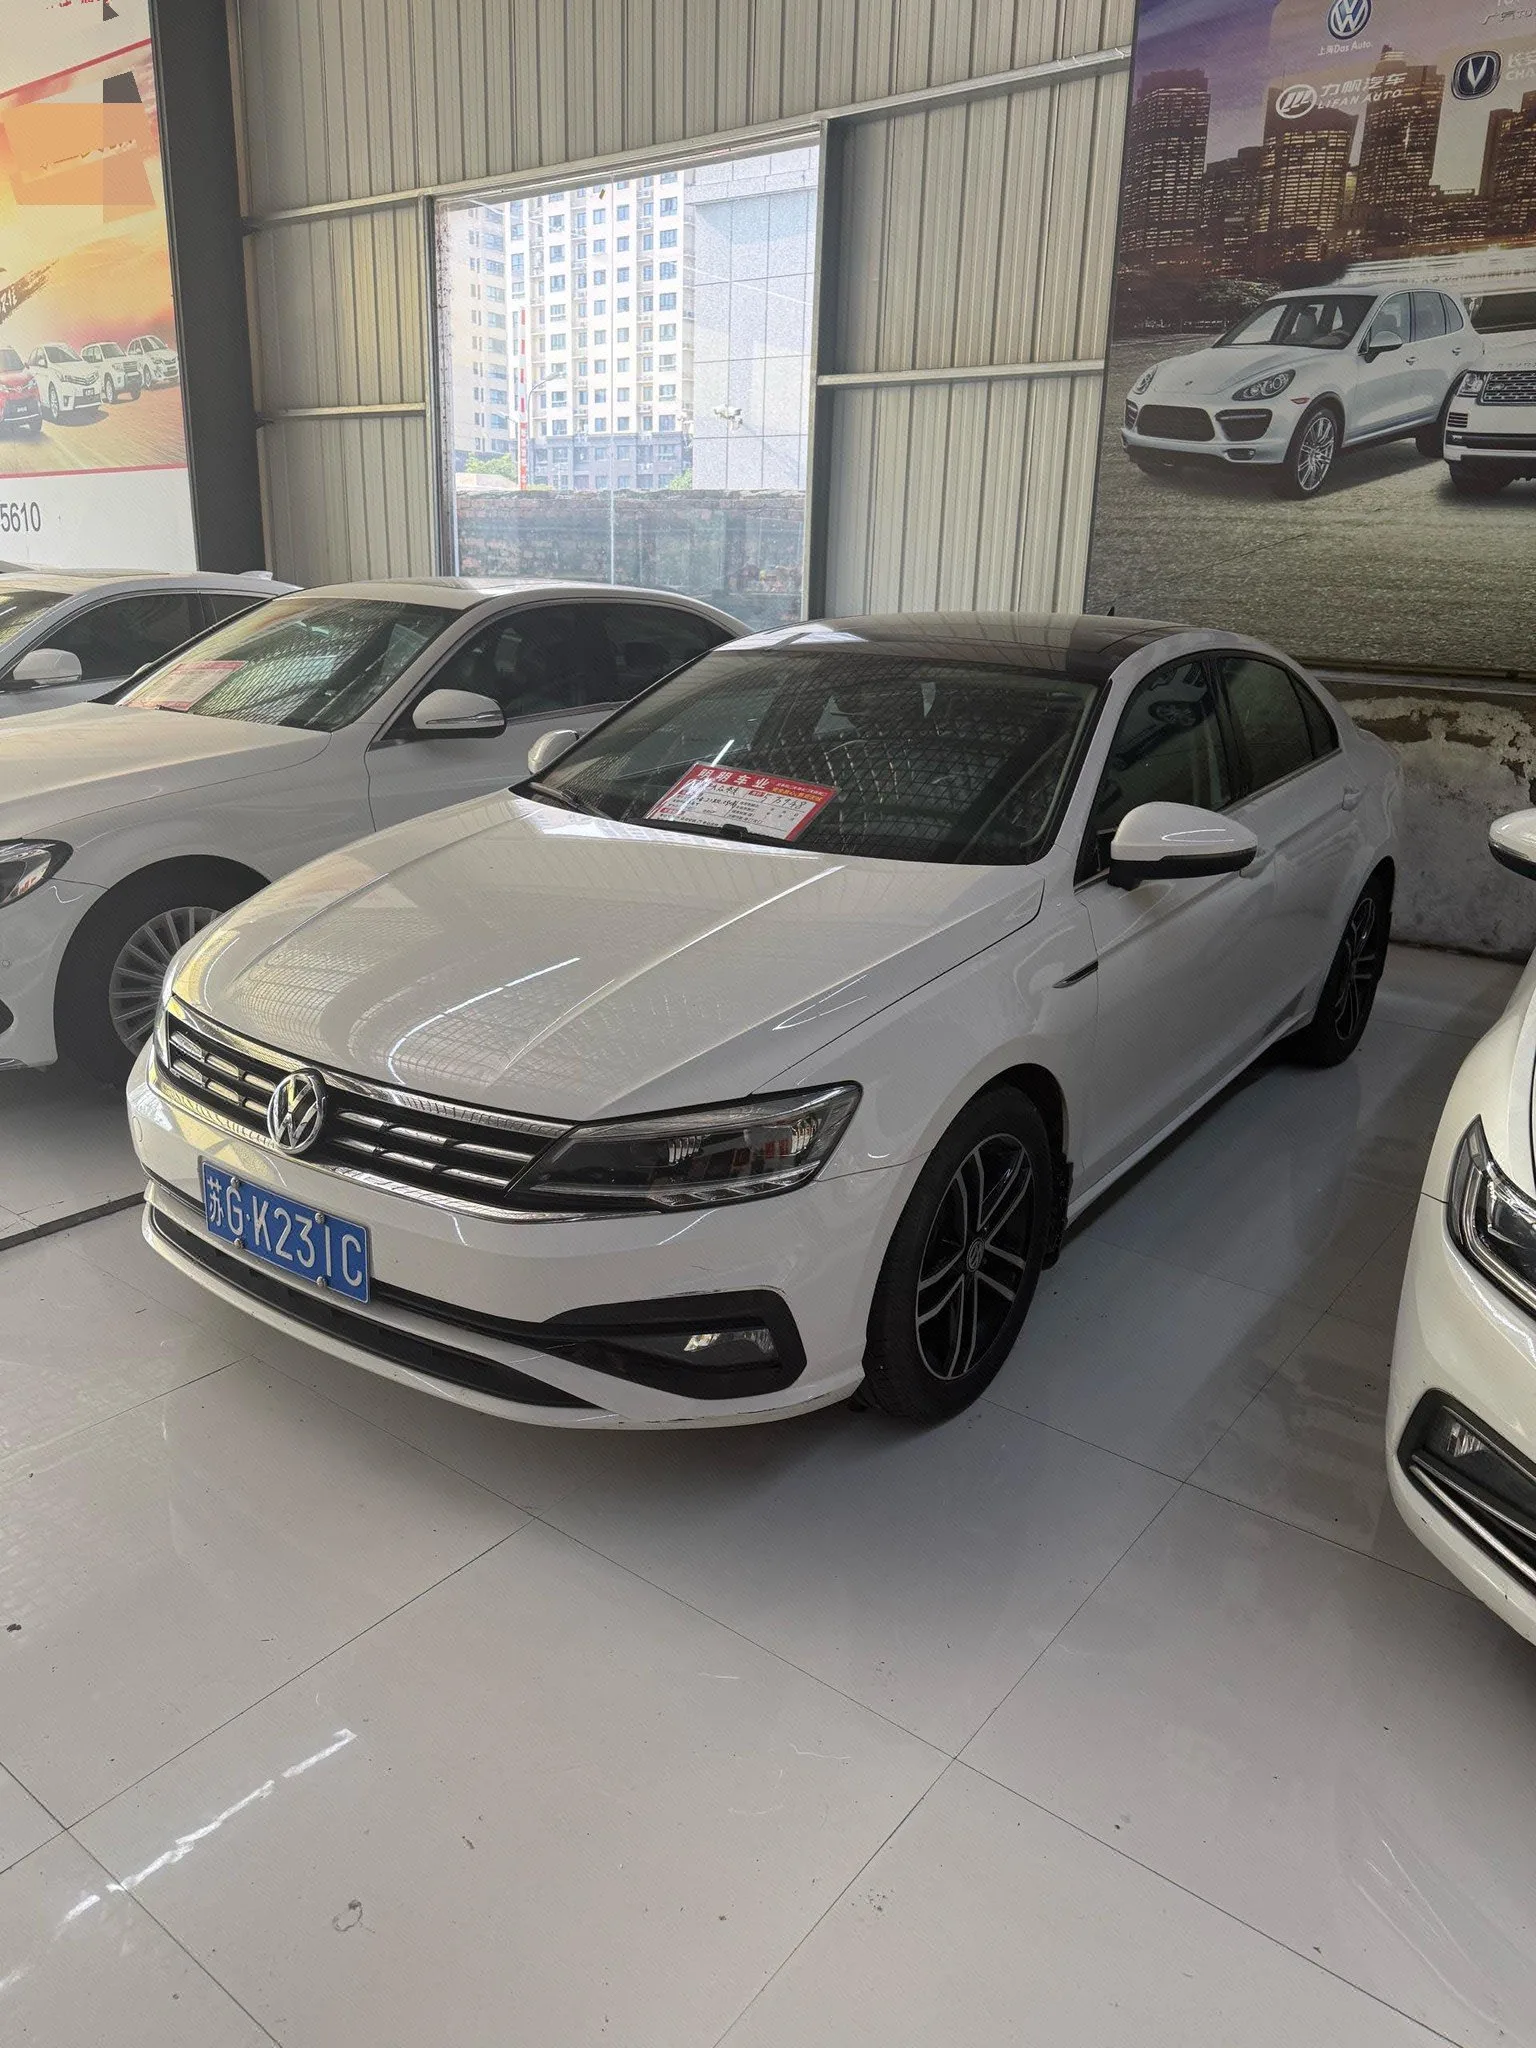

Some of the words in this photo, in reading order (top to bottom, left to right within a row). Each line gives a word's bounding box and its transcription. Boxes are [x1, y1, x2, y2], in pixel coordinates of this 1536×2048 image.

[1320, 72, 1408, 97] 力帆汽车
[1318, 95, 1361, 109] LIFAN
[1361, 89, 1404, 103] AUTO
